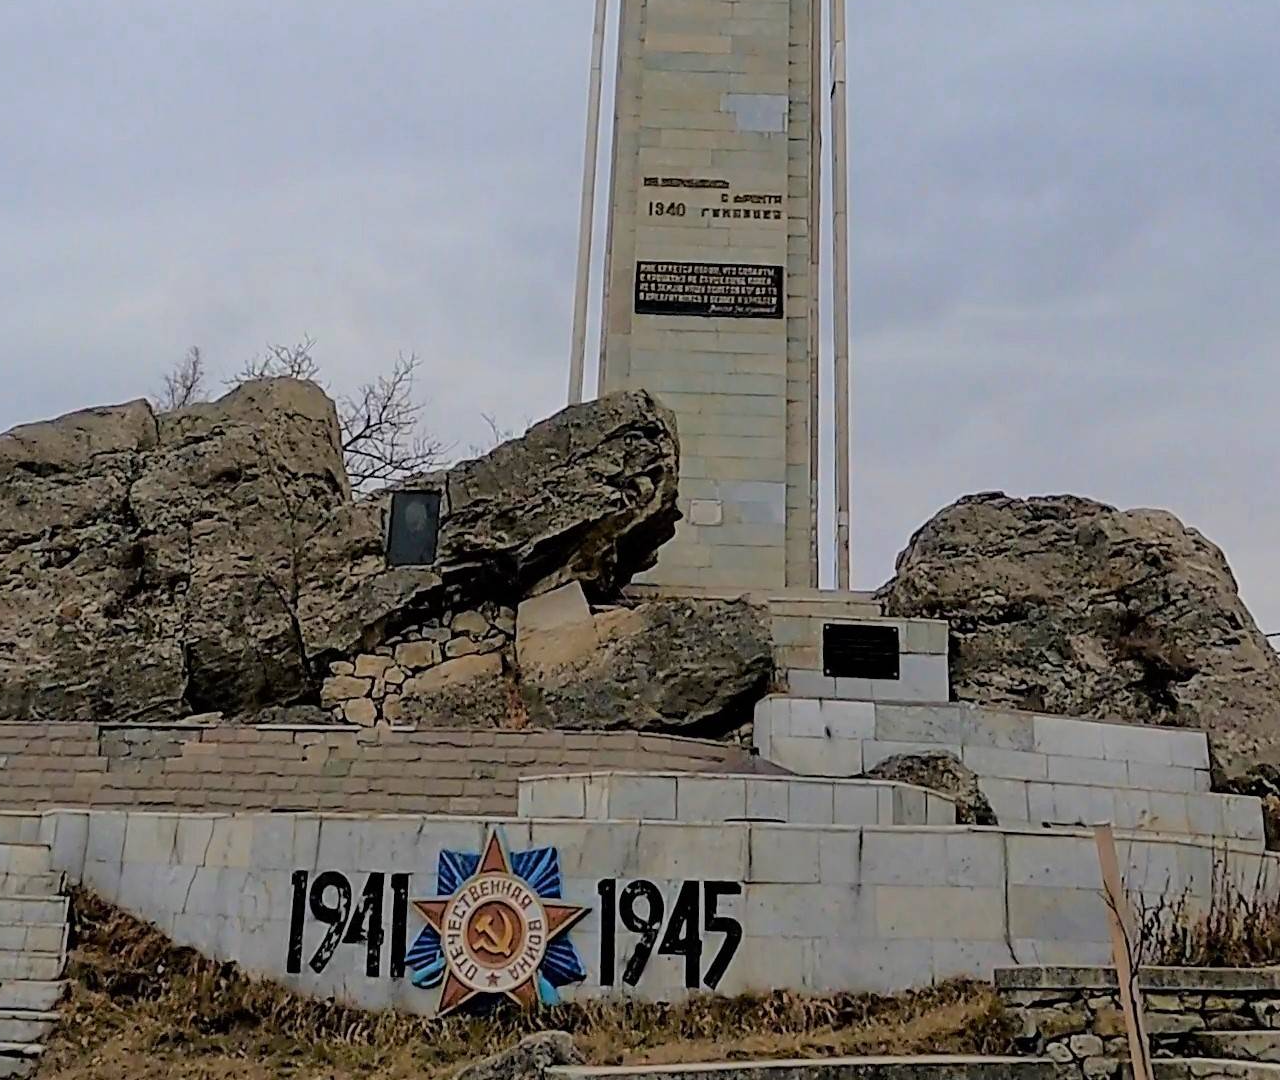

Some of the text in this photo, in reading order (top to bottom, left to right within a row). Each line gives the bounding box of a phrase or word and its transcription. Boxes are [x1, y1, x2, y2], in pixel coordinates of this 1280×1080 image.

[649, 201, 686, 217] 1340
[286, 870, 413, 978] 1941
[448, 880, 533, 980] ОТЕЧЕСТВЕННАЯ
[596, 878, 744, 990] 1945
